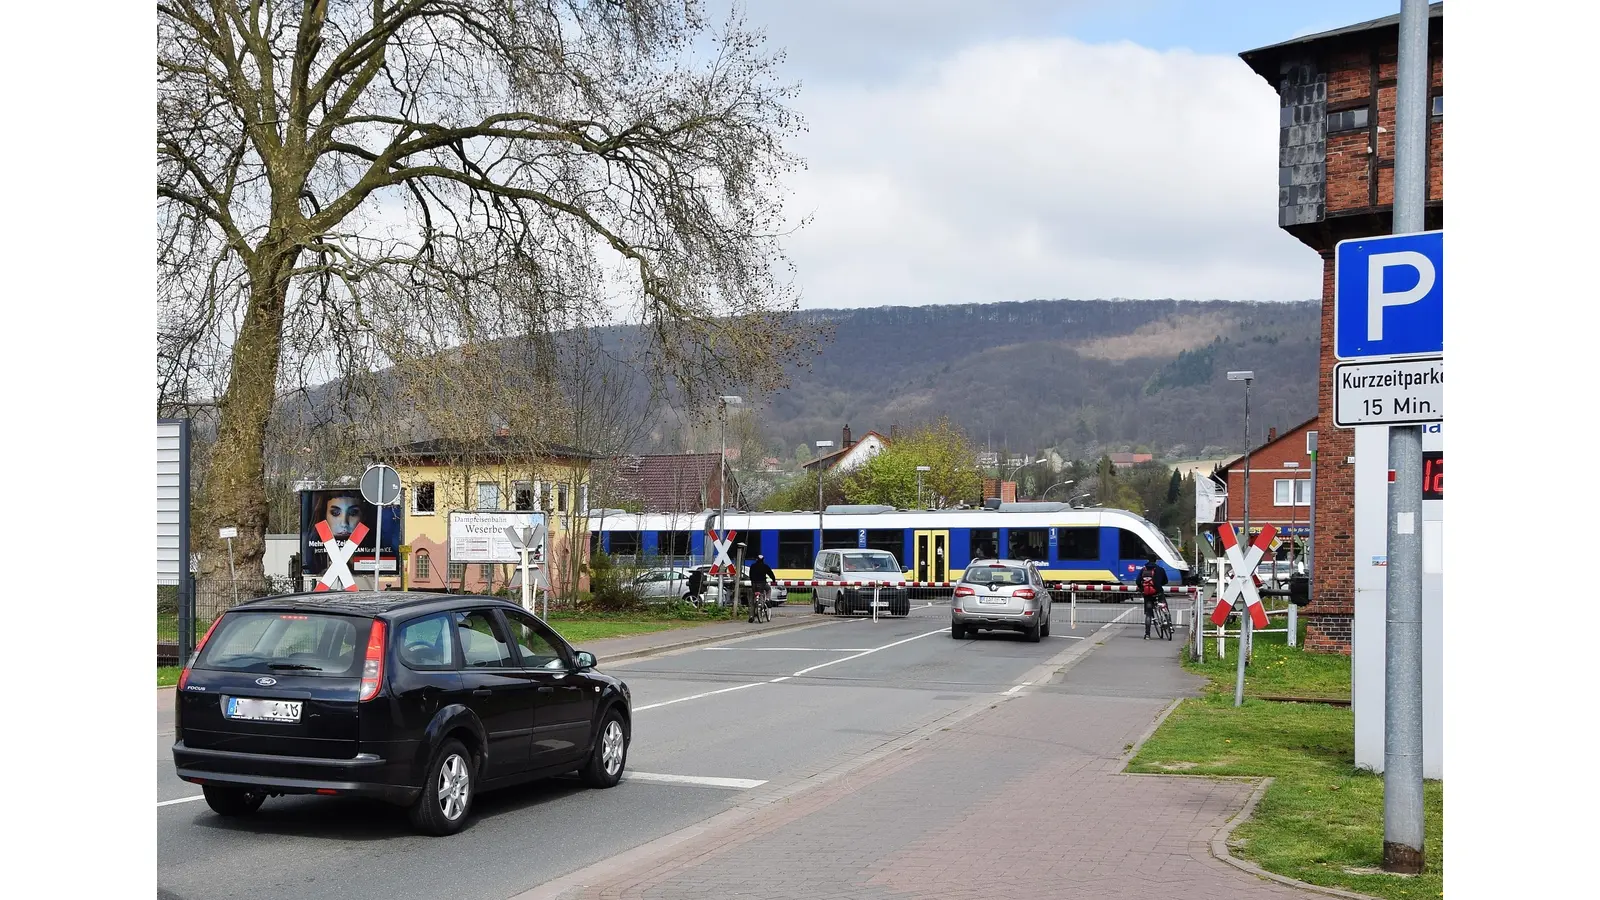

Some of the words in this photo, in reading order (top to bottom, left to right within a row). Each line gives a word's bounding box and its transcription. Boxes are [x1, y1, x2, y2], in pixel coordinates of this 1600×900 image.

[1367, 251, 1436, 341] P
[1363, 398, 1383, 416] 15
[1394, 397, 1437, 415] Min.
[454, 515, 507, 523] Dampfeisenbahn
[859, 529, 865, 538] 2
[1050, 528, 1056, 536] 1
